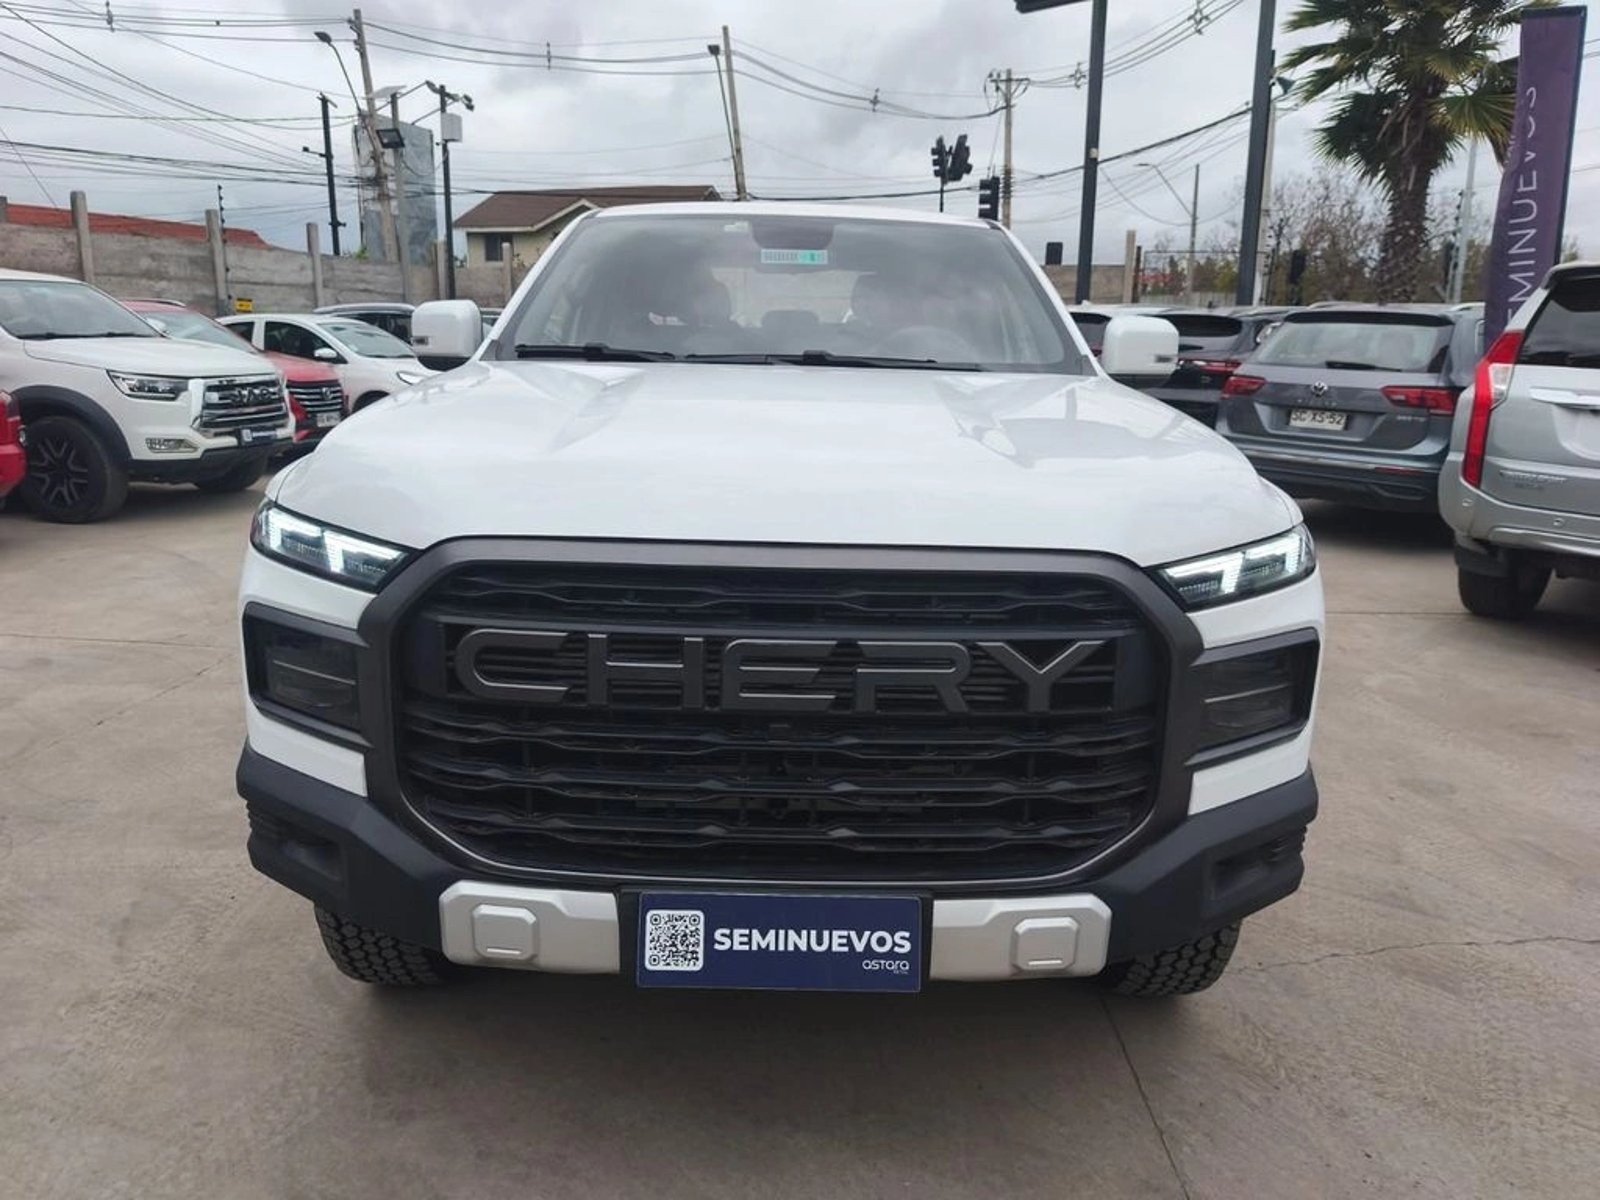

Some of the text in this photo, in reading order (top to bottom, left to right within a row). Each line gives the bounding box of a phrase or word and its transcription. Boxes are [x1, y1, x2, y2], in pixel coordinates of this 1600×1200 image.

[455, 627, 1105, 713] CHERY
[713, 928, 912, 954] SEMINUEVOS
[862, 959, 910, 970] astara
